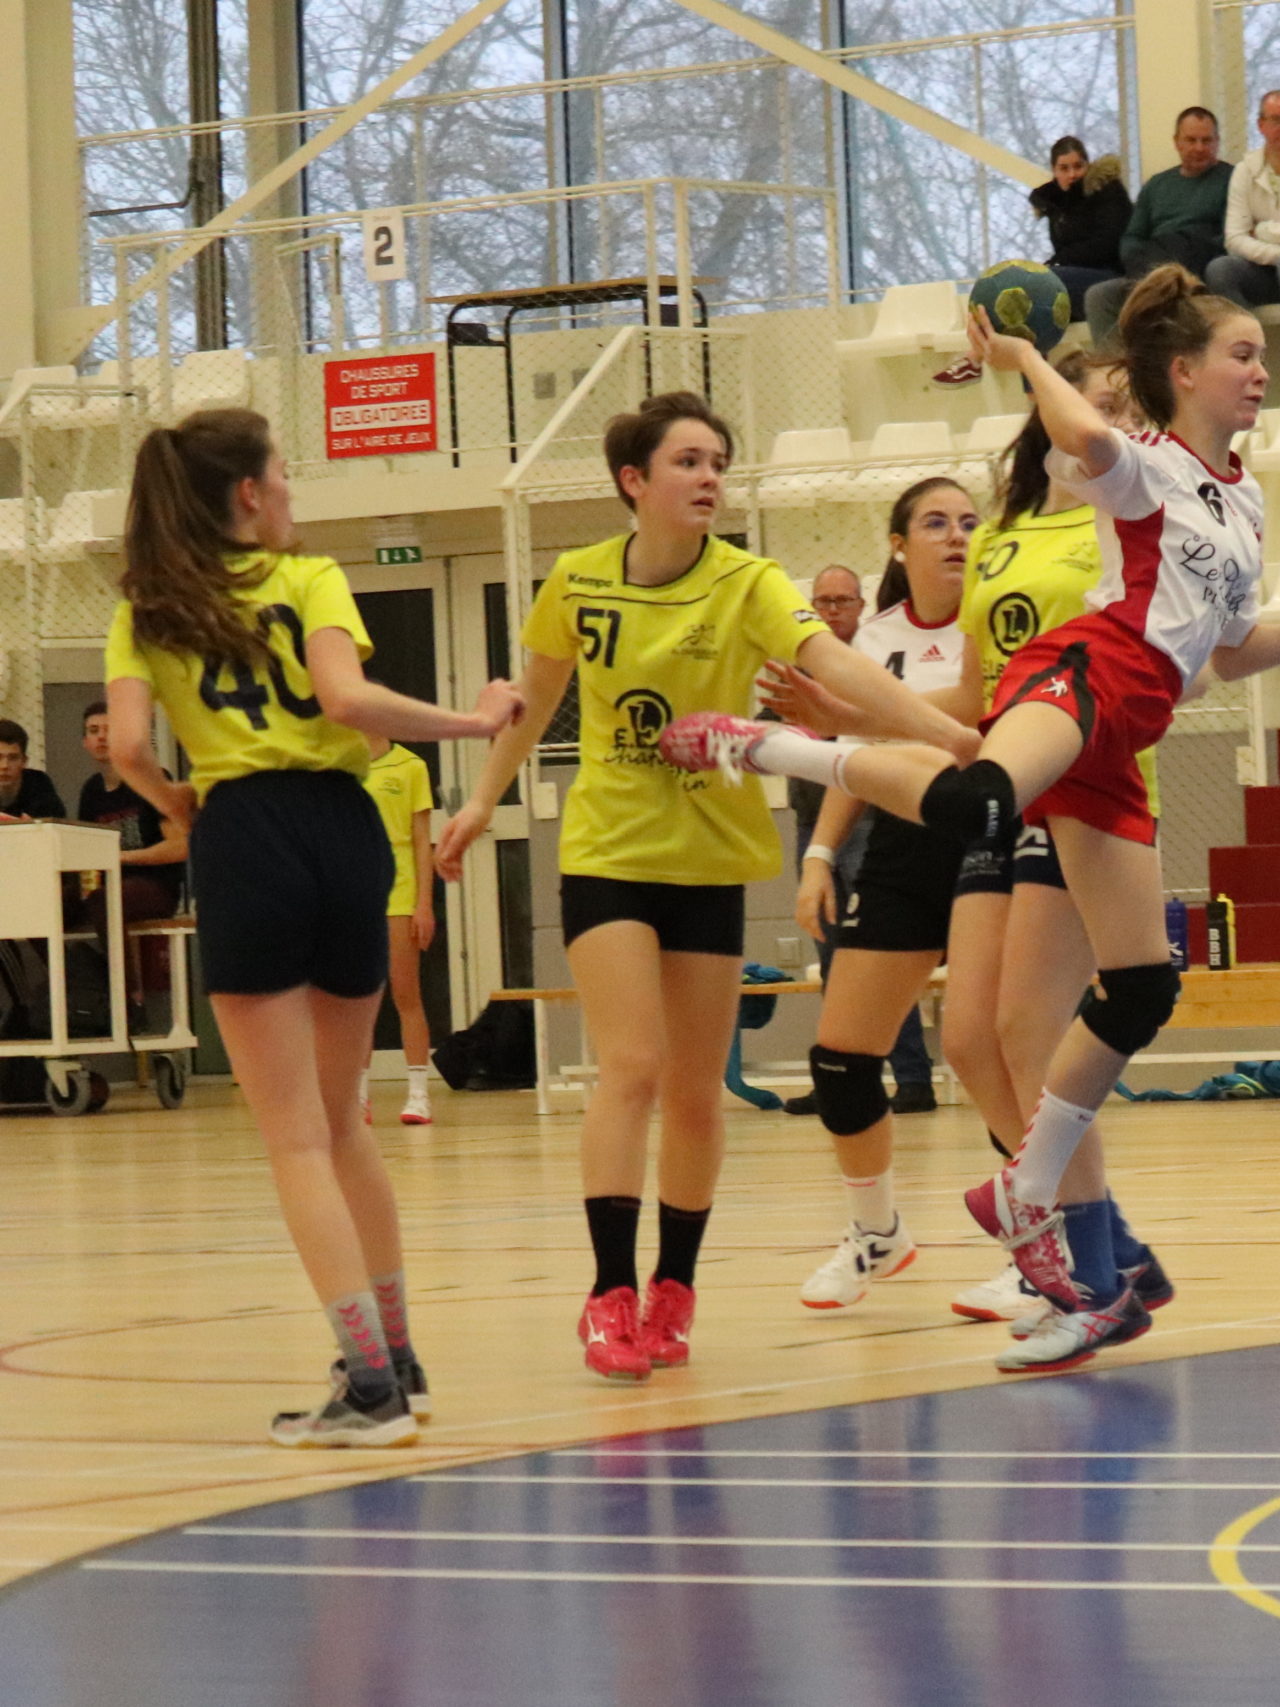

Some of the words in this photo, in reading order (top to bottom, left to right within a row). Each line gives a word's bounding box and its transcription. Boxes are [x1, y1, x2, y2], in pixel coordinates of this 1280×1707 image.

[374, 226, 394, 266] 2
[340, 363, 419, 384] CHAUSSURES
[351, 385, 368, 399] DE
[368, 381, 408, 398] SPORT
[333, 403, 428, 427] OBLIGATOIRES
[332, 438, 352, 450] SUR
[388, 434, 404, 445] DE
[404, 431, 431, 444] JEUX
[1197, 482, 1226, 527] 6
[200, 603, 323, 732] 40
